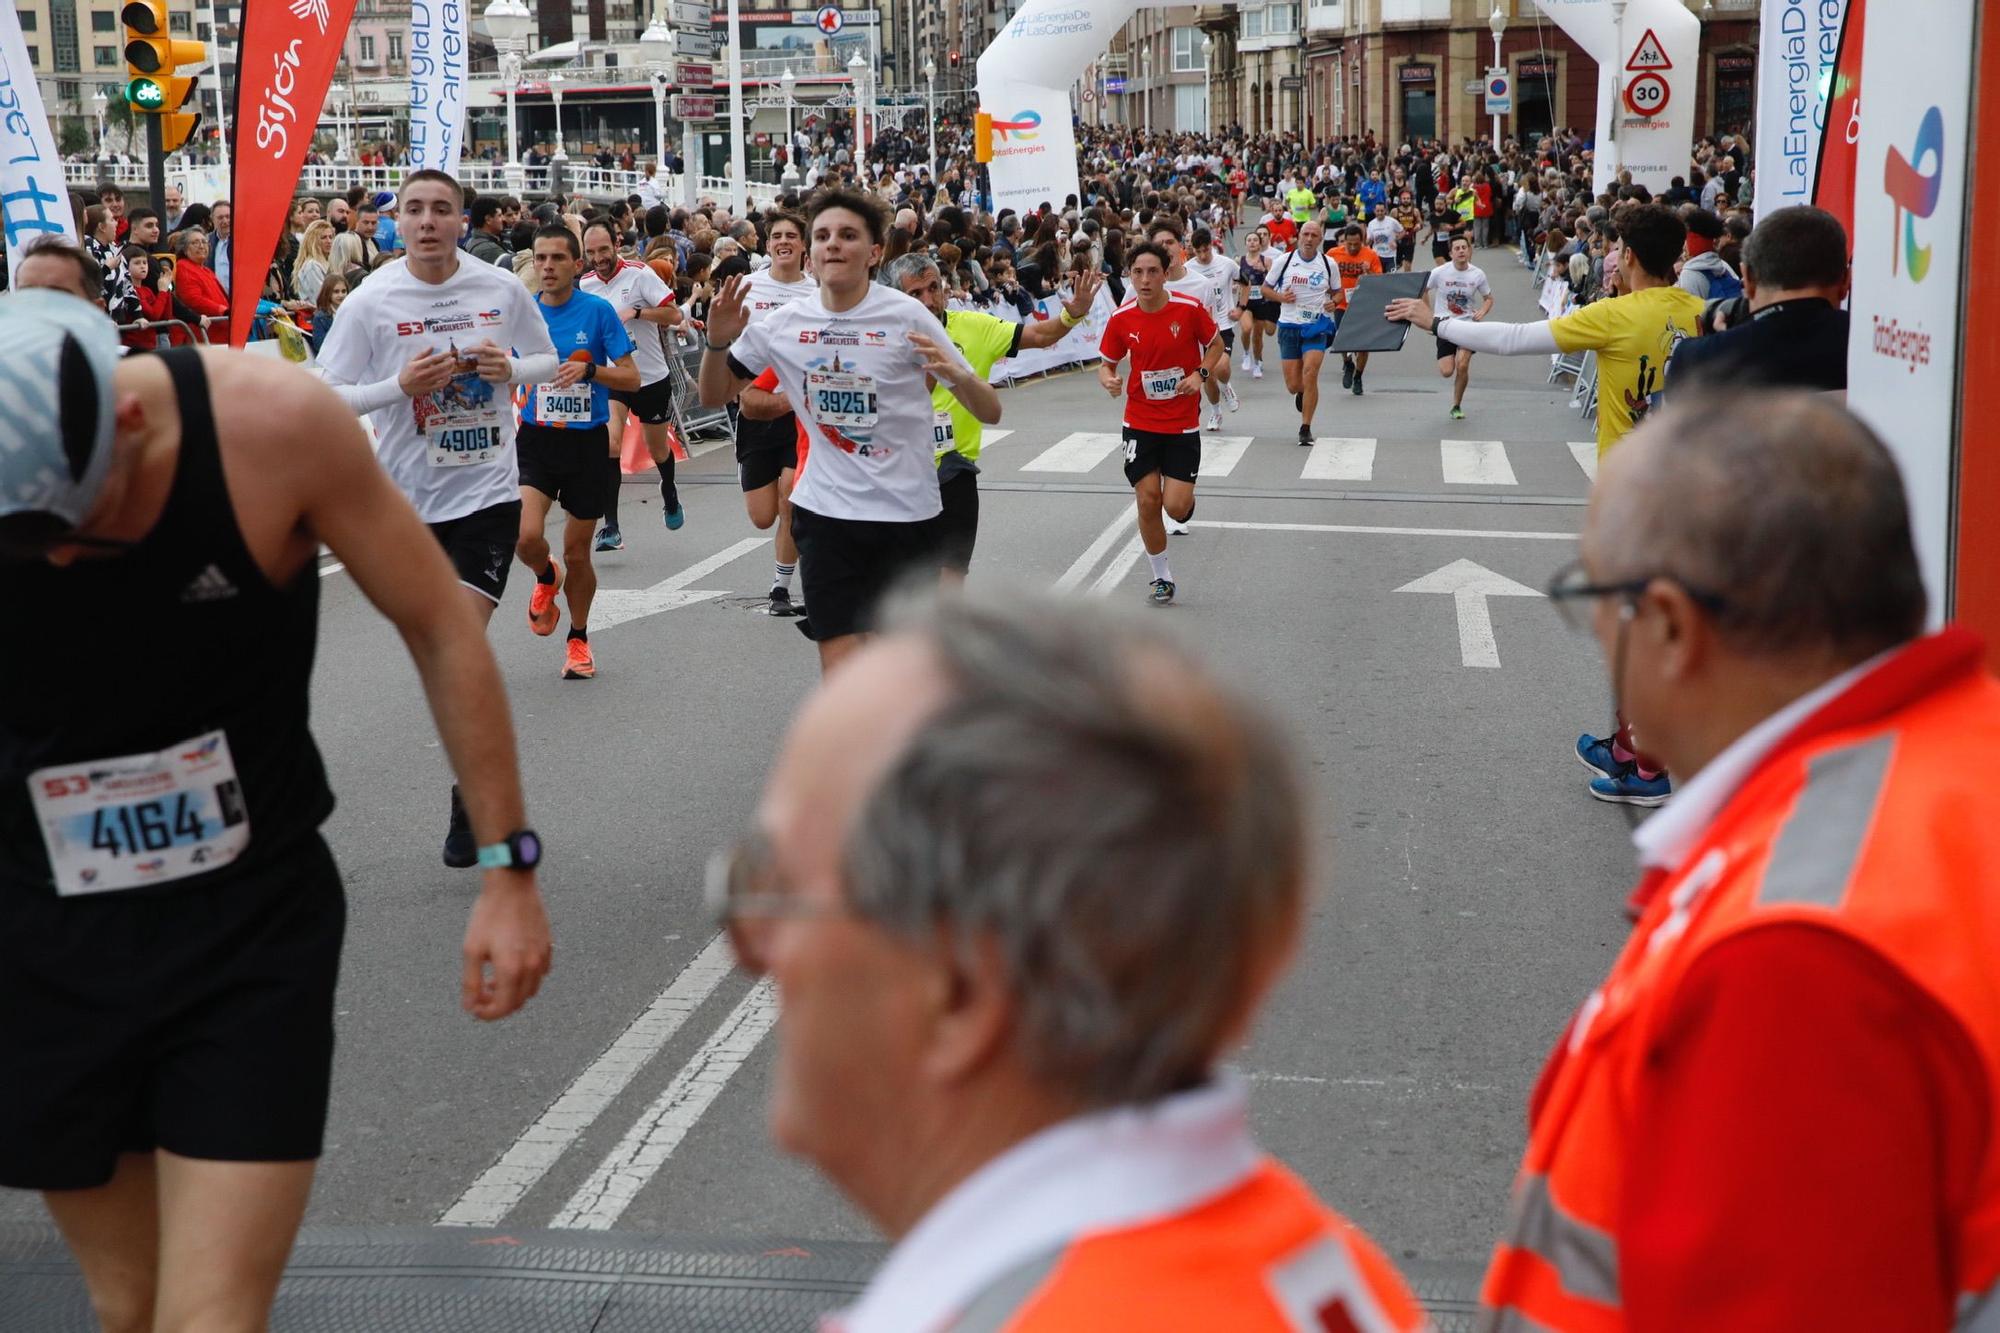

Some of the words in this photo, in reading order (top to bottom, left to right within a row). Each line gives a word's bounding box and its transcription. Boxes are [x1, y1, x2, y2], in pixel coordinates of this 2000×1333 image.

[256, 38, 303, 160] gijón
[1636, 86, 1660, 101] 30
[1291, 276, 1309, 285] Run
[397, 322, 424, 336] 53
[432, 320, 475, 333] SANSILVESTRE
[799, 332, 817, 344] 53
[823, 337, 860, 346] SANSILVESTRE
[1152, 378, 1178, 392] 1942
[546, 397, 582, 413] 3405
[819, 390, 864, 414] 3925
[439, 426, 489, 452] 4909
[44, 775, 90, 799] 53
[90, 792, 205, 858] 4164
